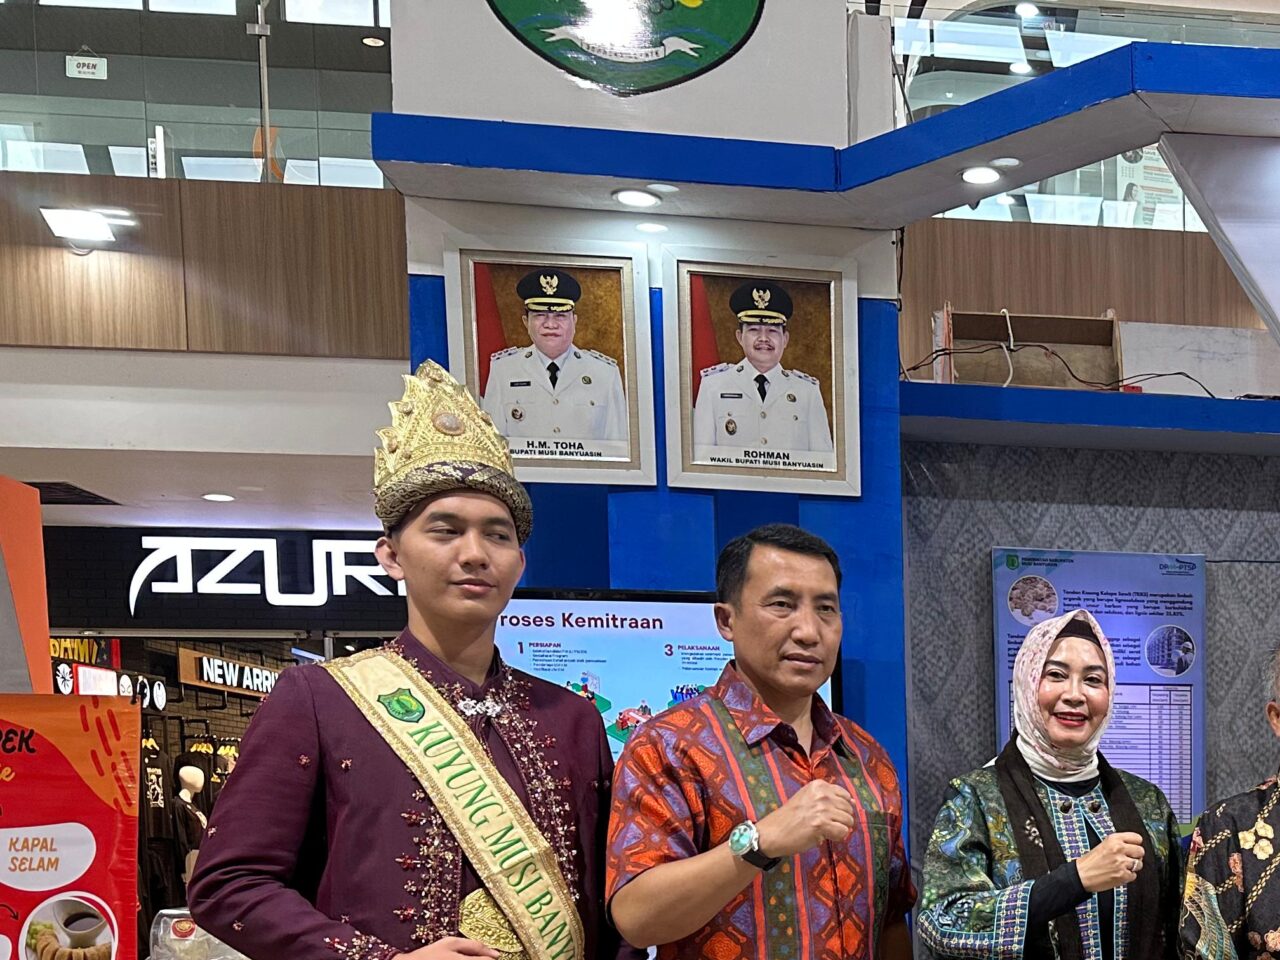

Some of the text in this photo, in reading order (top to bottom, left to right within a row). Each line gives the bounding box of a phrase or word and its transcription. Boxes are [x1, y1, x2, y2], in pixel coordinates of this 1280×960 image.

[76, 62, 97, 70] OPEN
[526, 440, 585, 451] H.M. TOHA
[510, 449, 537, 457] BUPATI
[559, 450, 602, 458] BANYUASIN
[743, 450, 790, 461] ROHMAN
[735, 458, 761, 466] BUPATI
[762, 459, 781, 467] MUSI
[782, 461, 824, 469] BANYUASIN
[128, 535, 407, 618] AZUR
[500, 612, 664, 630] roses Kemitraan
[517, 642, 524, 654] 1
[664, 643, 674, 657] 3
[202, 656, 240, 687] NEW
[407, 720, 504, 829] KUYUNG
[481, 824, 546, 896] MUSI
[8, 837, 58, 852] KAPAL
[8, 856, 60, 872] SELAM
